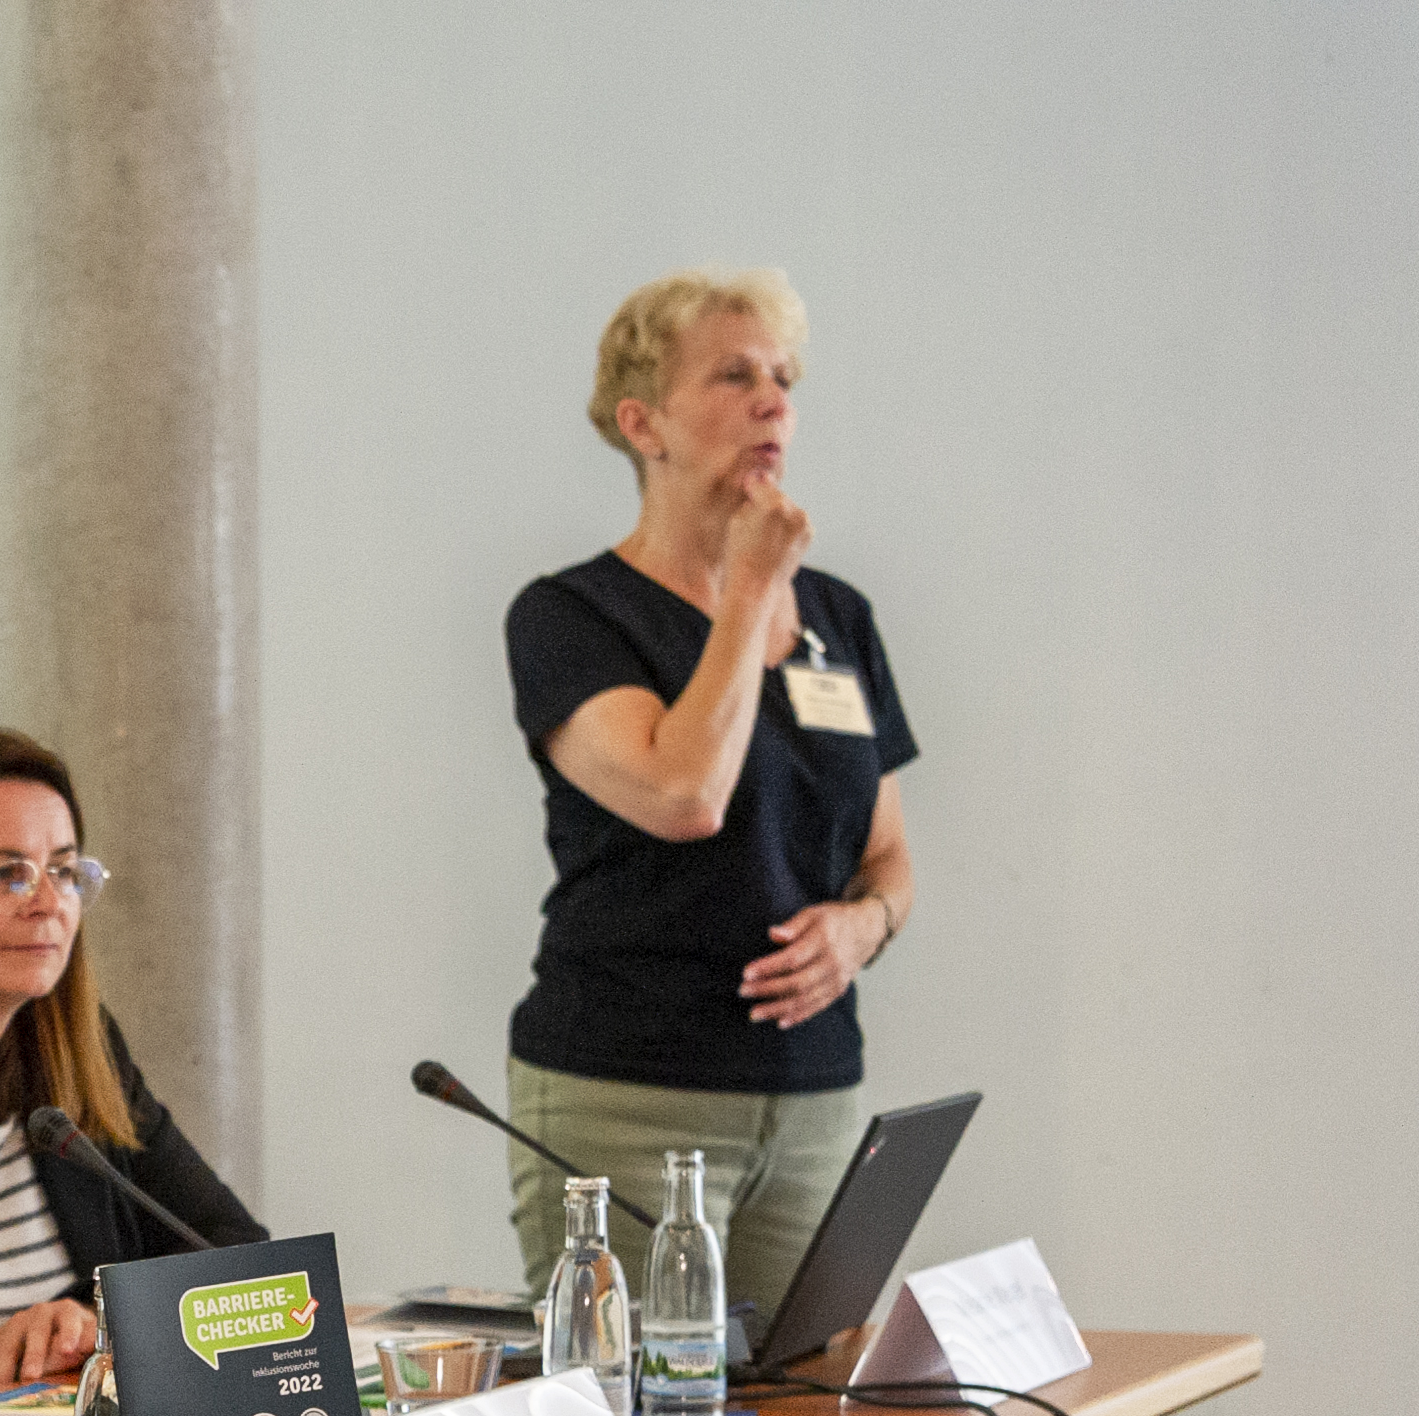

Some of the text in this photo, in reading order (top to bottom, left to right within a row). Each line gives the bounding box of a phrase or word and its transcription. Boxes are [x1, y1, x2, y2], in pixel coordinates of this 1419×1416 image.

[193, 1287, 295, 1319] BARRIERE-
[197, 1312, 285, 1342] CHECKER
[272, 1347, 318, 1361] Bericht zur
[252, 1360, 320, 1377] Inklusionswoche
[278, 1373, 323, 1396] 2022
